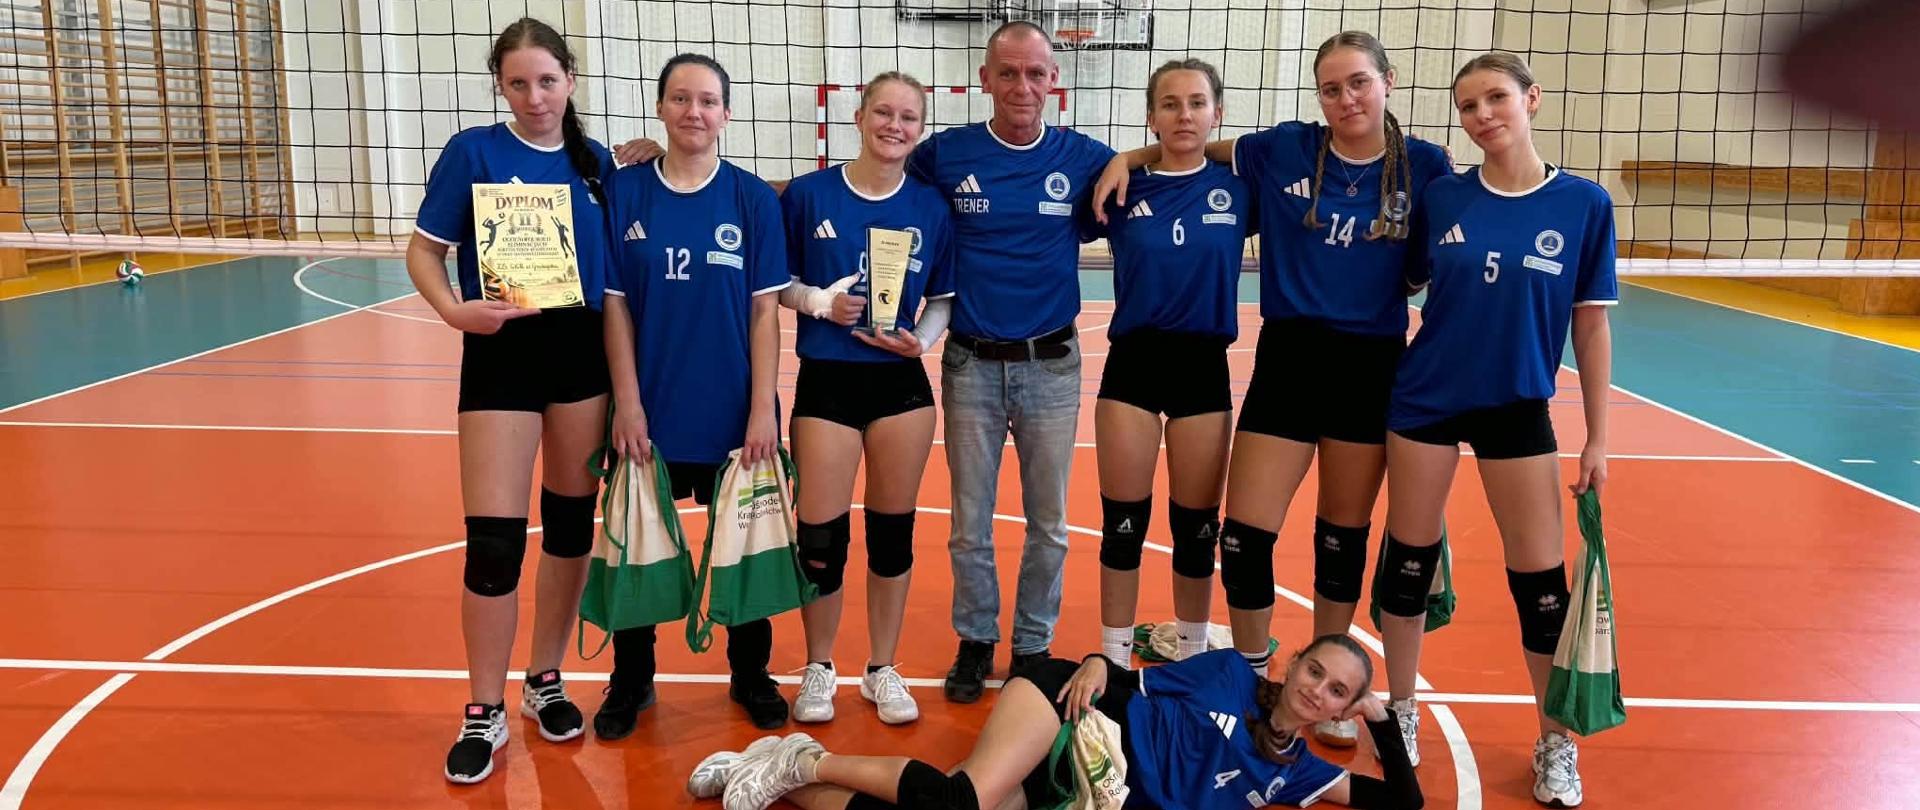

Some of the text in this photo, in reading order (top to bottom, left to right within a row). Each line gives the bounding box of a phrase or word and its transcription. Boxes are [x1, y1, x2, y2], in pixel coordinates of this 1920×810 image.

[495, 195, 553, 210] DYPLOM
[953, 198, 989, 213] TRENER
[1172, 218, 1185, 246] 6
[1324, 213, 1356, 248] 14
[665, 247, 691, 280] 12
[1484, 251, 1501, 284] 5
[1214, 769, 1241, 789] 4
